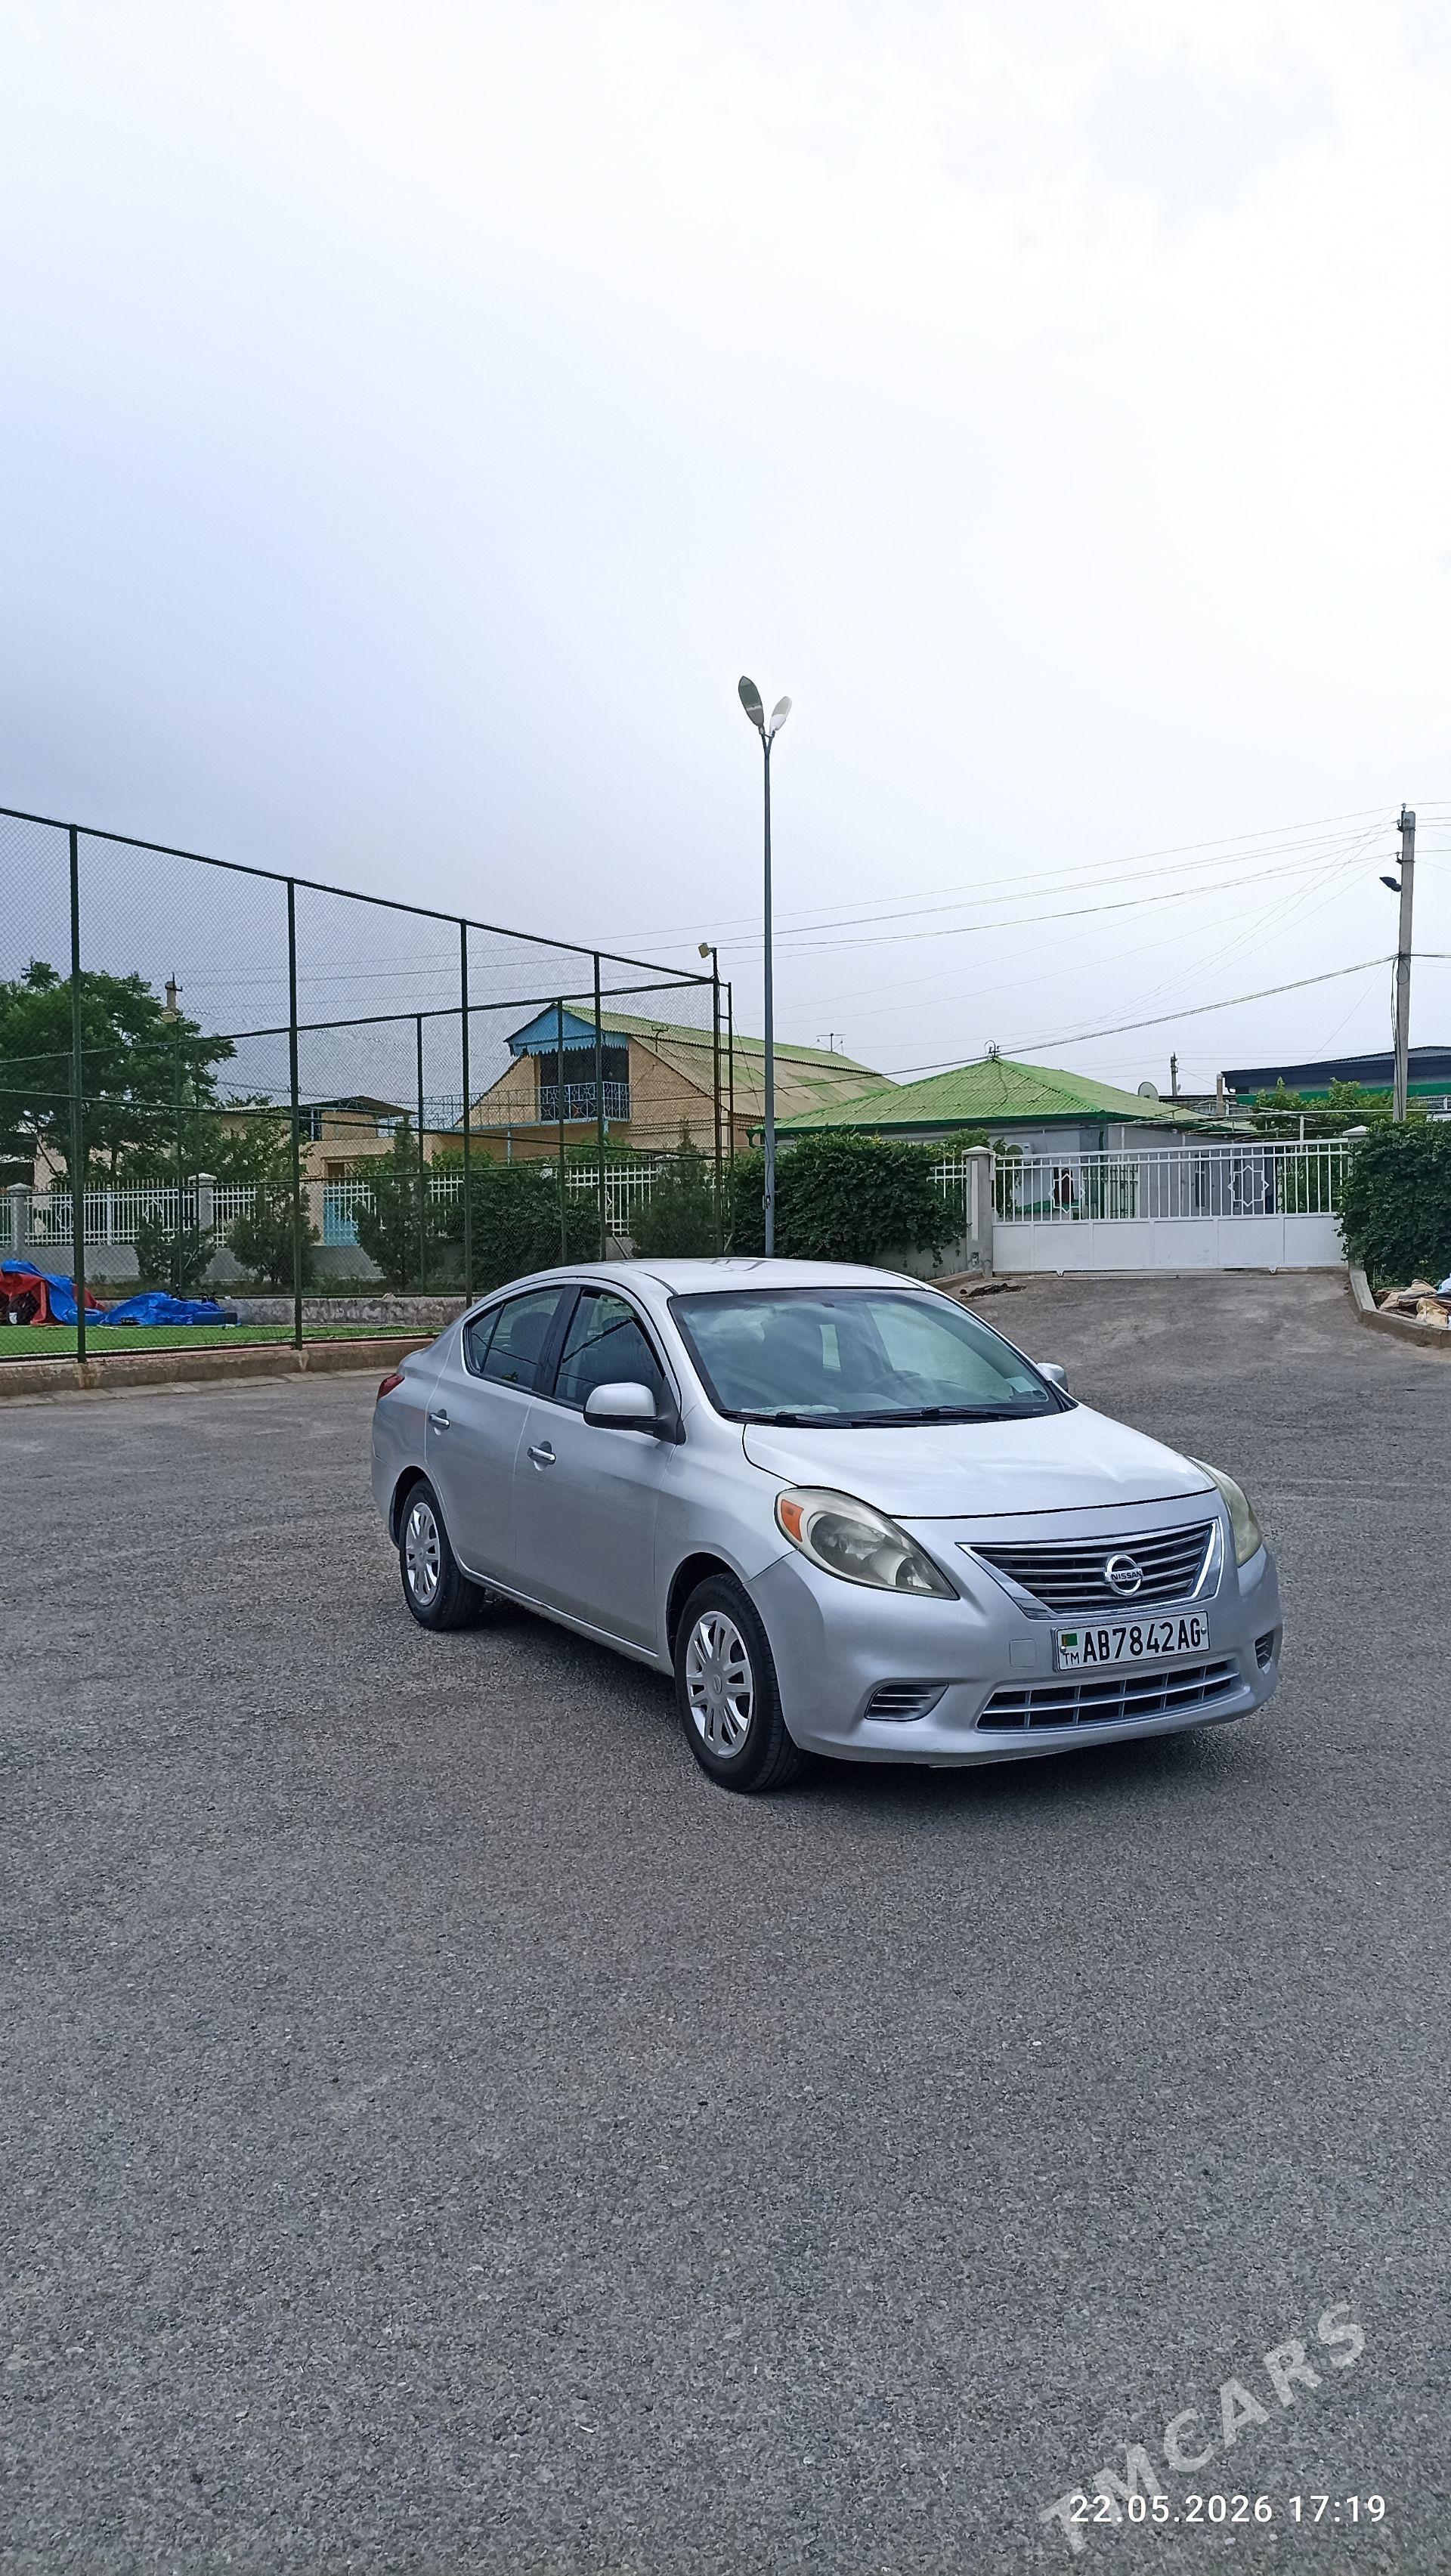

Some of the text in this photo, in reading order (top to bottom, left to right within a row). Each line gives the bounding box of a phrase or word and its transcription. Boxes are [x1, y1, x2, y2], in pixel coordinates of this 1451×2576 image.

[1111, 1571, 1141, 1580] NISSAN
[1083, 1618, 1202, 1662] AB7842AG
[1063, 1653, 1080, 1665] TM
